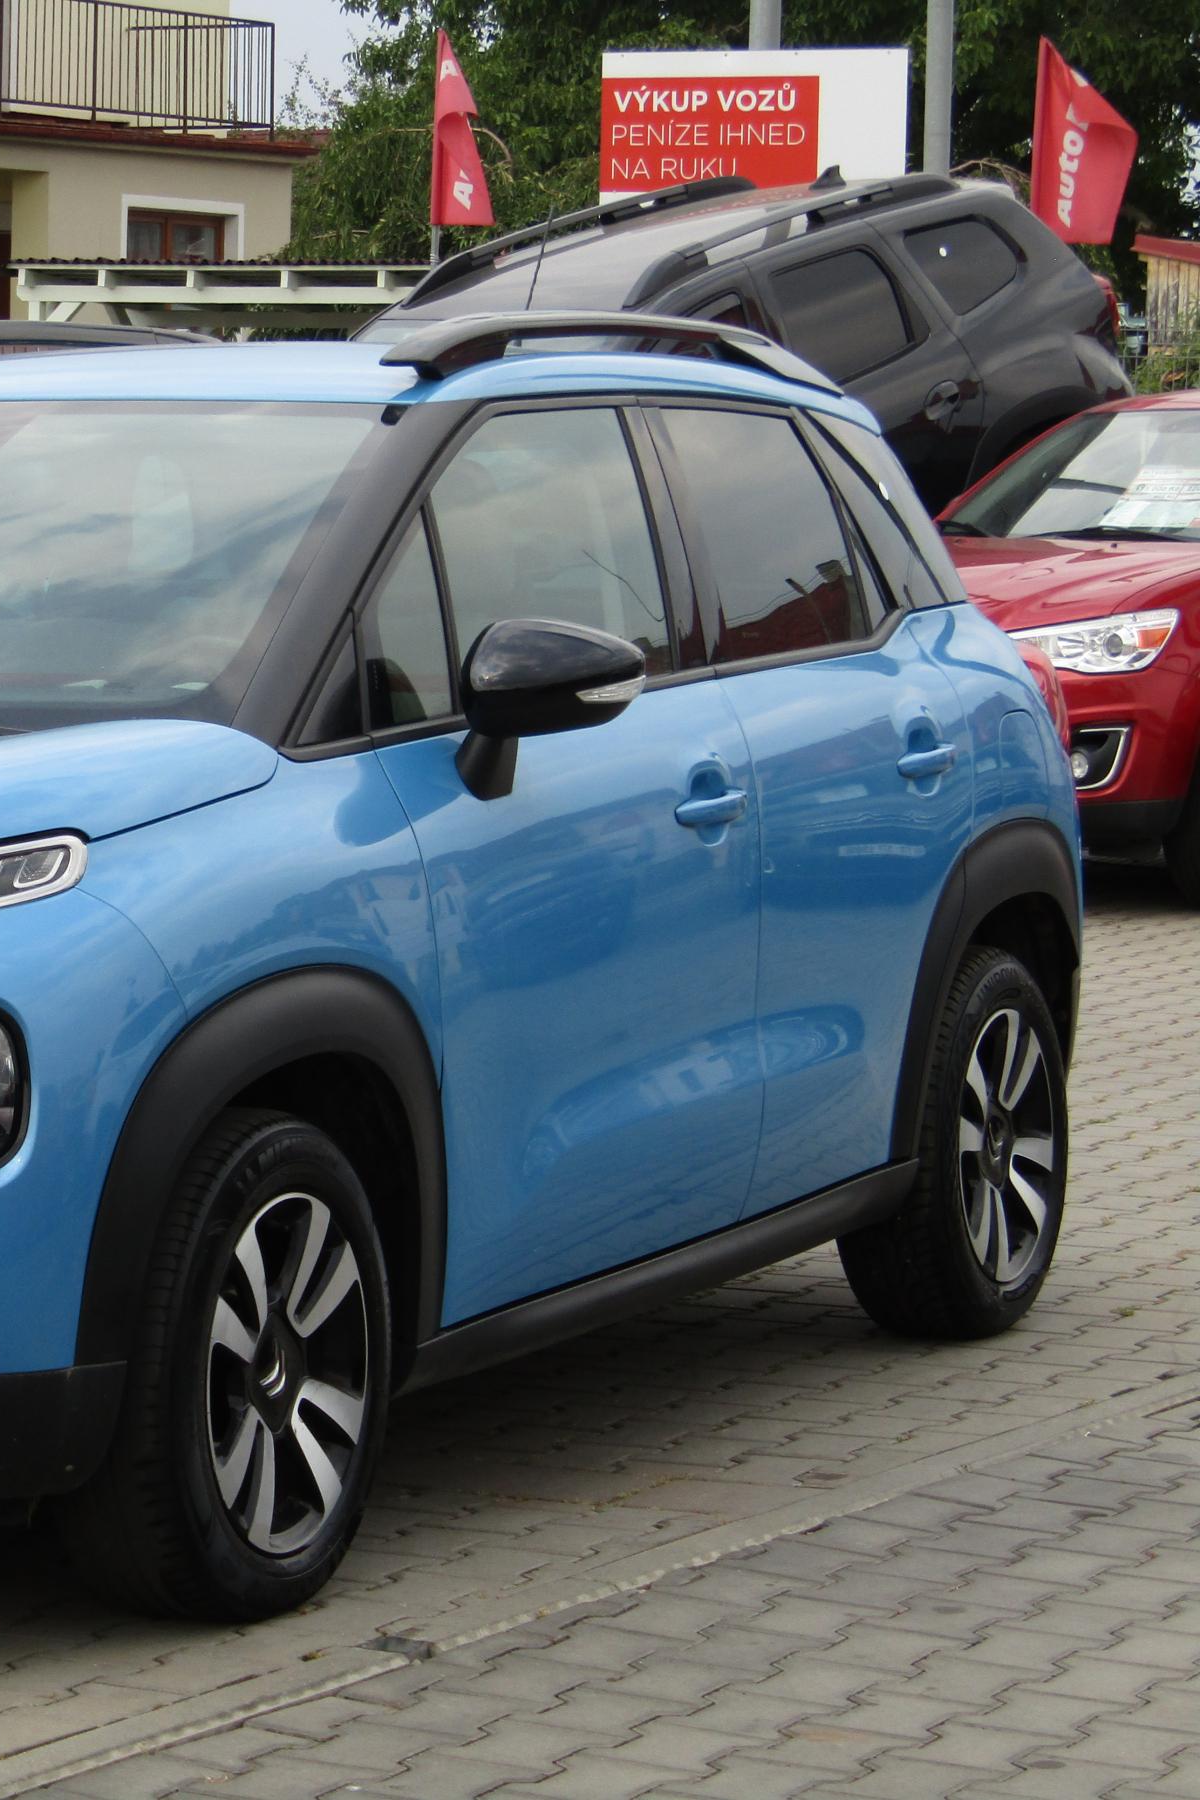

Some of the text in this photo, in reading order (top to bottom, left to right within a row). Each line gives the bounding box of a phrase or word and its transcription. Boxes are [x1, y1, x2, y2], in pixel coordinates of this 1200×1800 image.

[613, 83, 796, 112] VÝKUP VOZŮ
[611, 120, 806, 146] PENÍZE IHNED
[611, 157, 737, 180] NA RUKU
